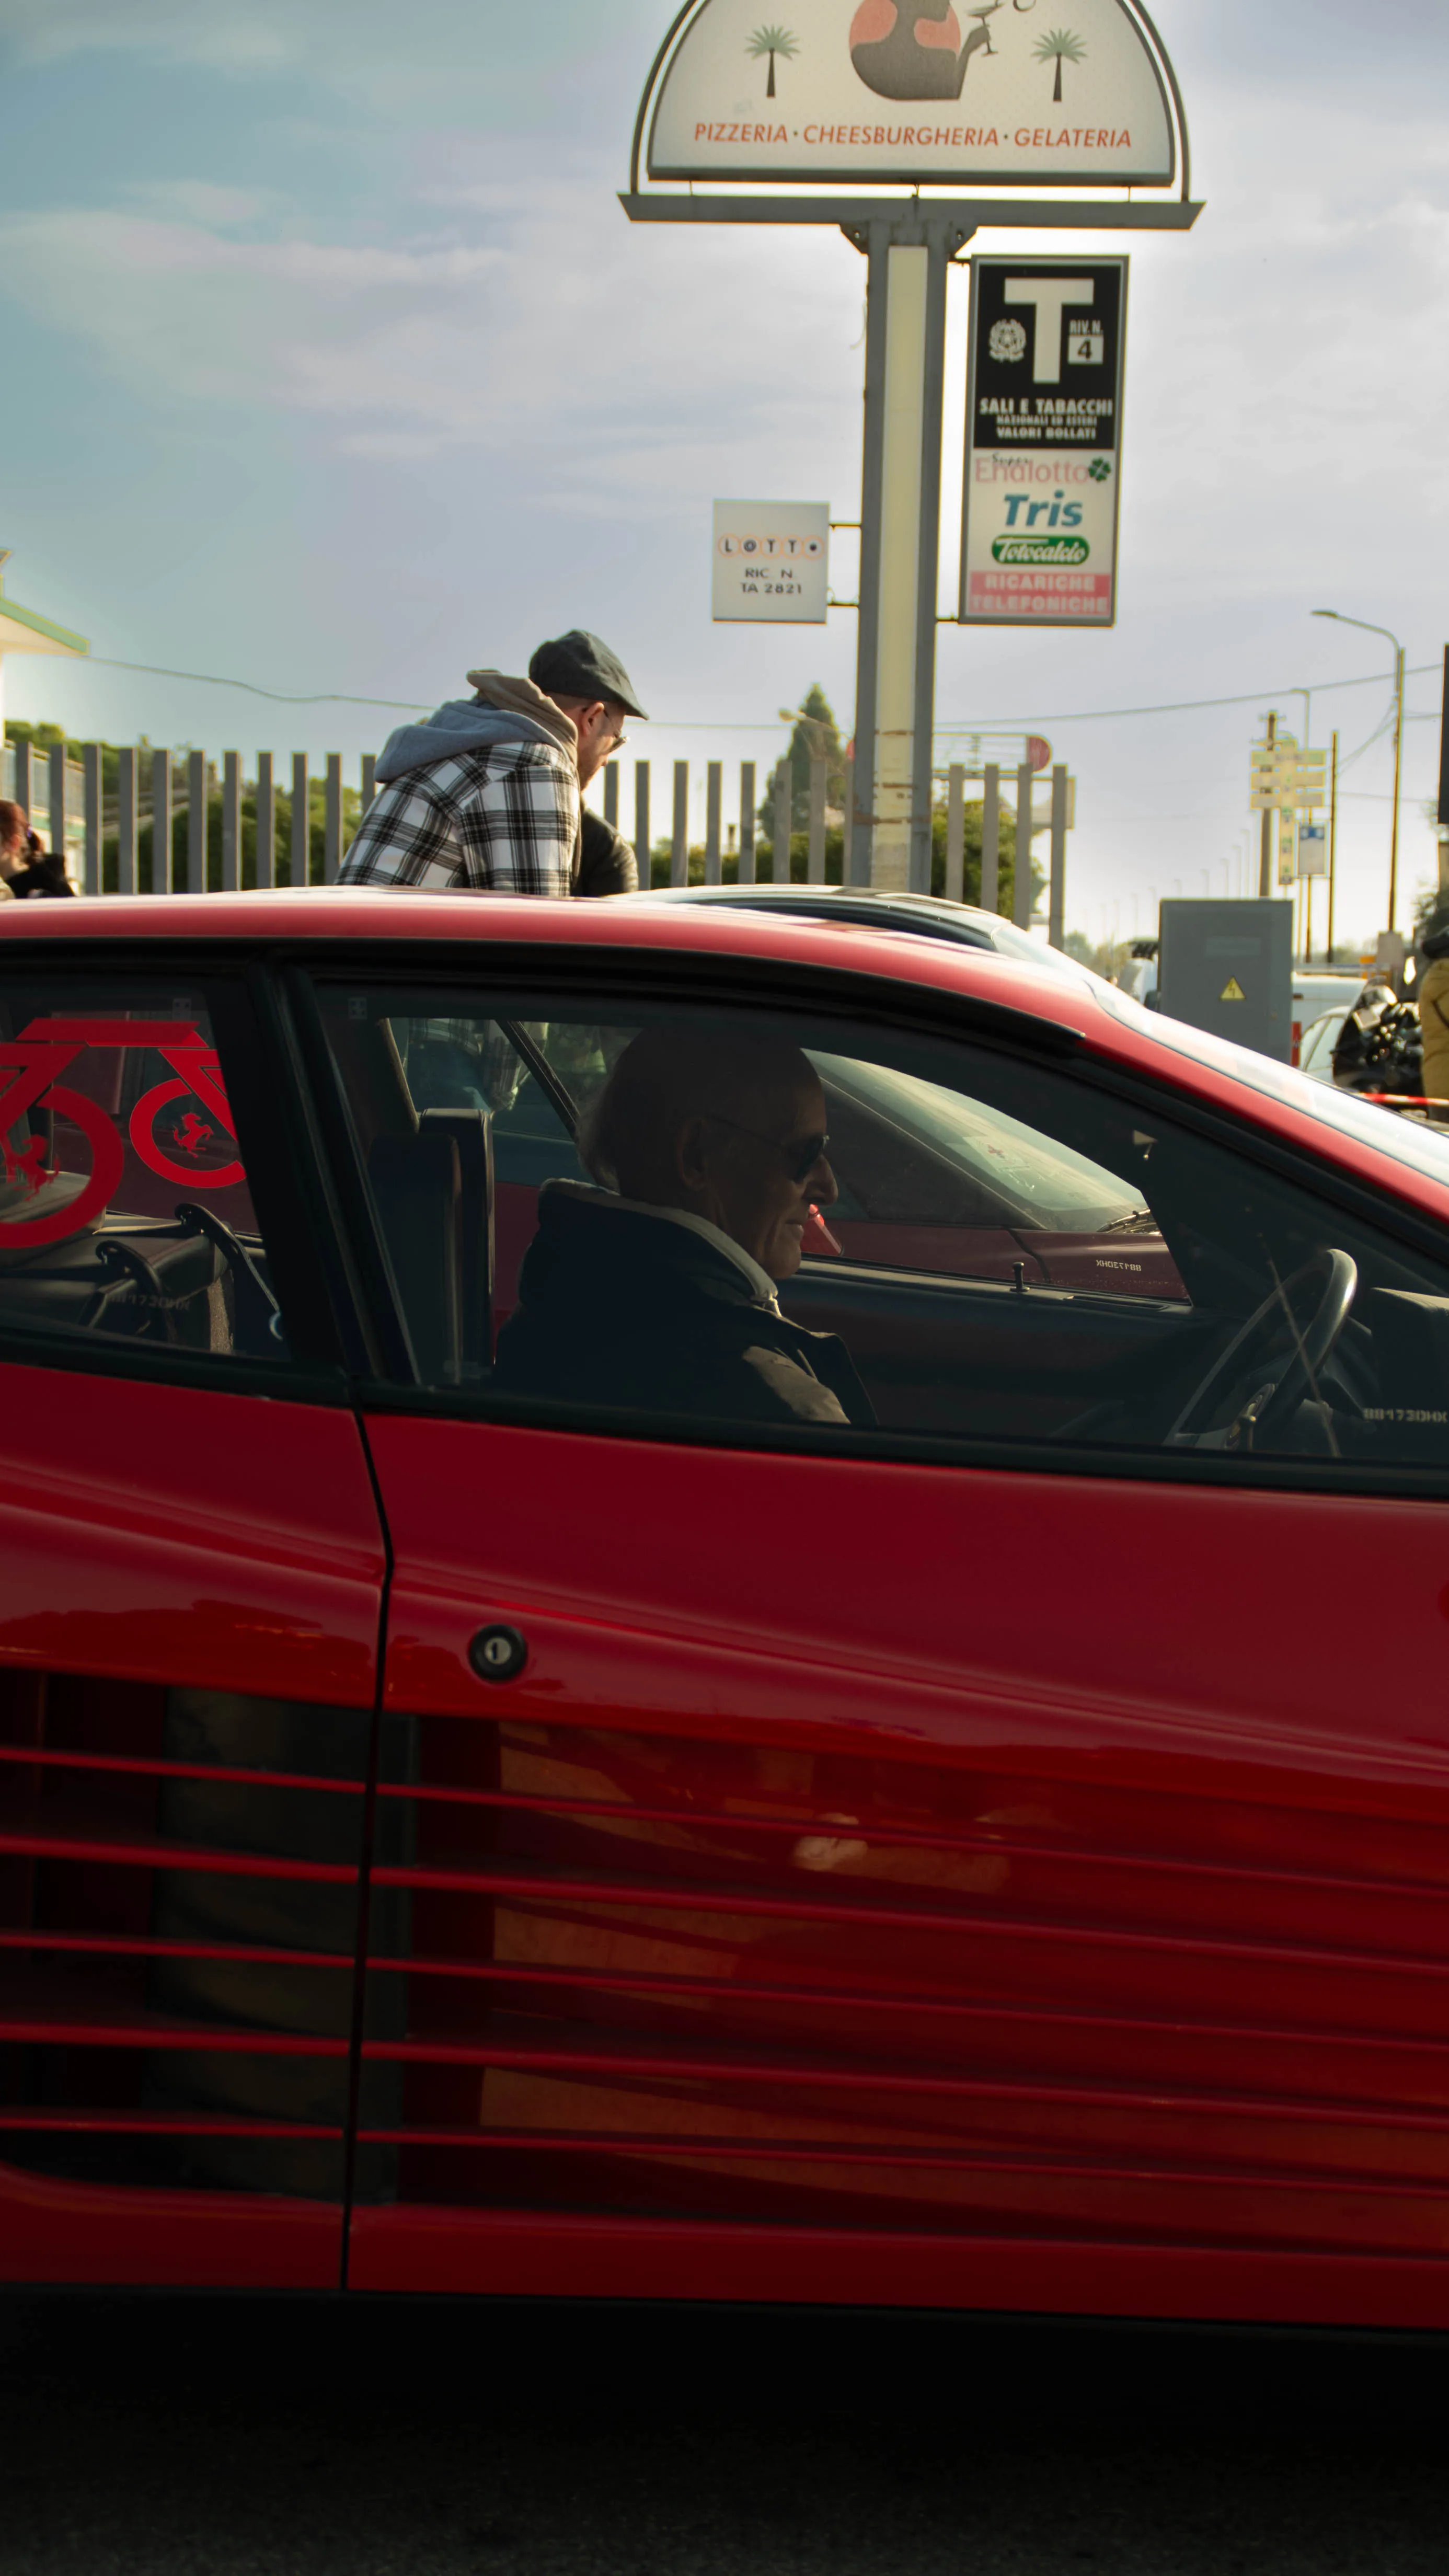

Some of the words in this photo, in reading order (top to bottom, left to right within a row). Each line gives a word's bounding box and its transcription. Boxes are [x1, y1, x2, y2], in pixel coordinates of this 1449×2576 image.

[694, 123, 788, 143] PIZZERIA
[803, 125, 999, 146] CHEESBURGHERIA
[1014, 128, 1132, 148] GELATERIA
[1004, 277, 1094, 384] T
[1077, 338, 1093, 361] 4
[980, 398, 1015, 415] SALI
[1020, 399, 1029, 415] E
[1036, 398, 1113, 416] TABACCHI
[996, 427, 1042, 439] VALORI
[1004, 489, 1084, 527] Tris
[996, 538, 1086, 562] Totocalcio
[741, 582, 758, 593] TA
[764, 582, 802, 594] 2821
[984, 573, 1096, 592] RICARICHE
[972, 594, 1109, 613] TELEFONICHE
